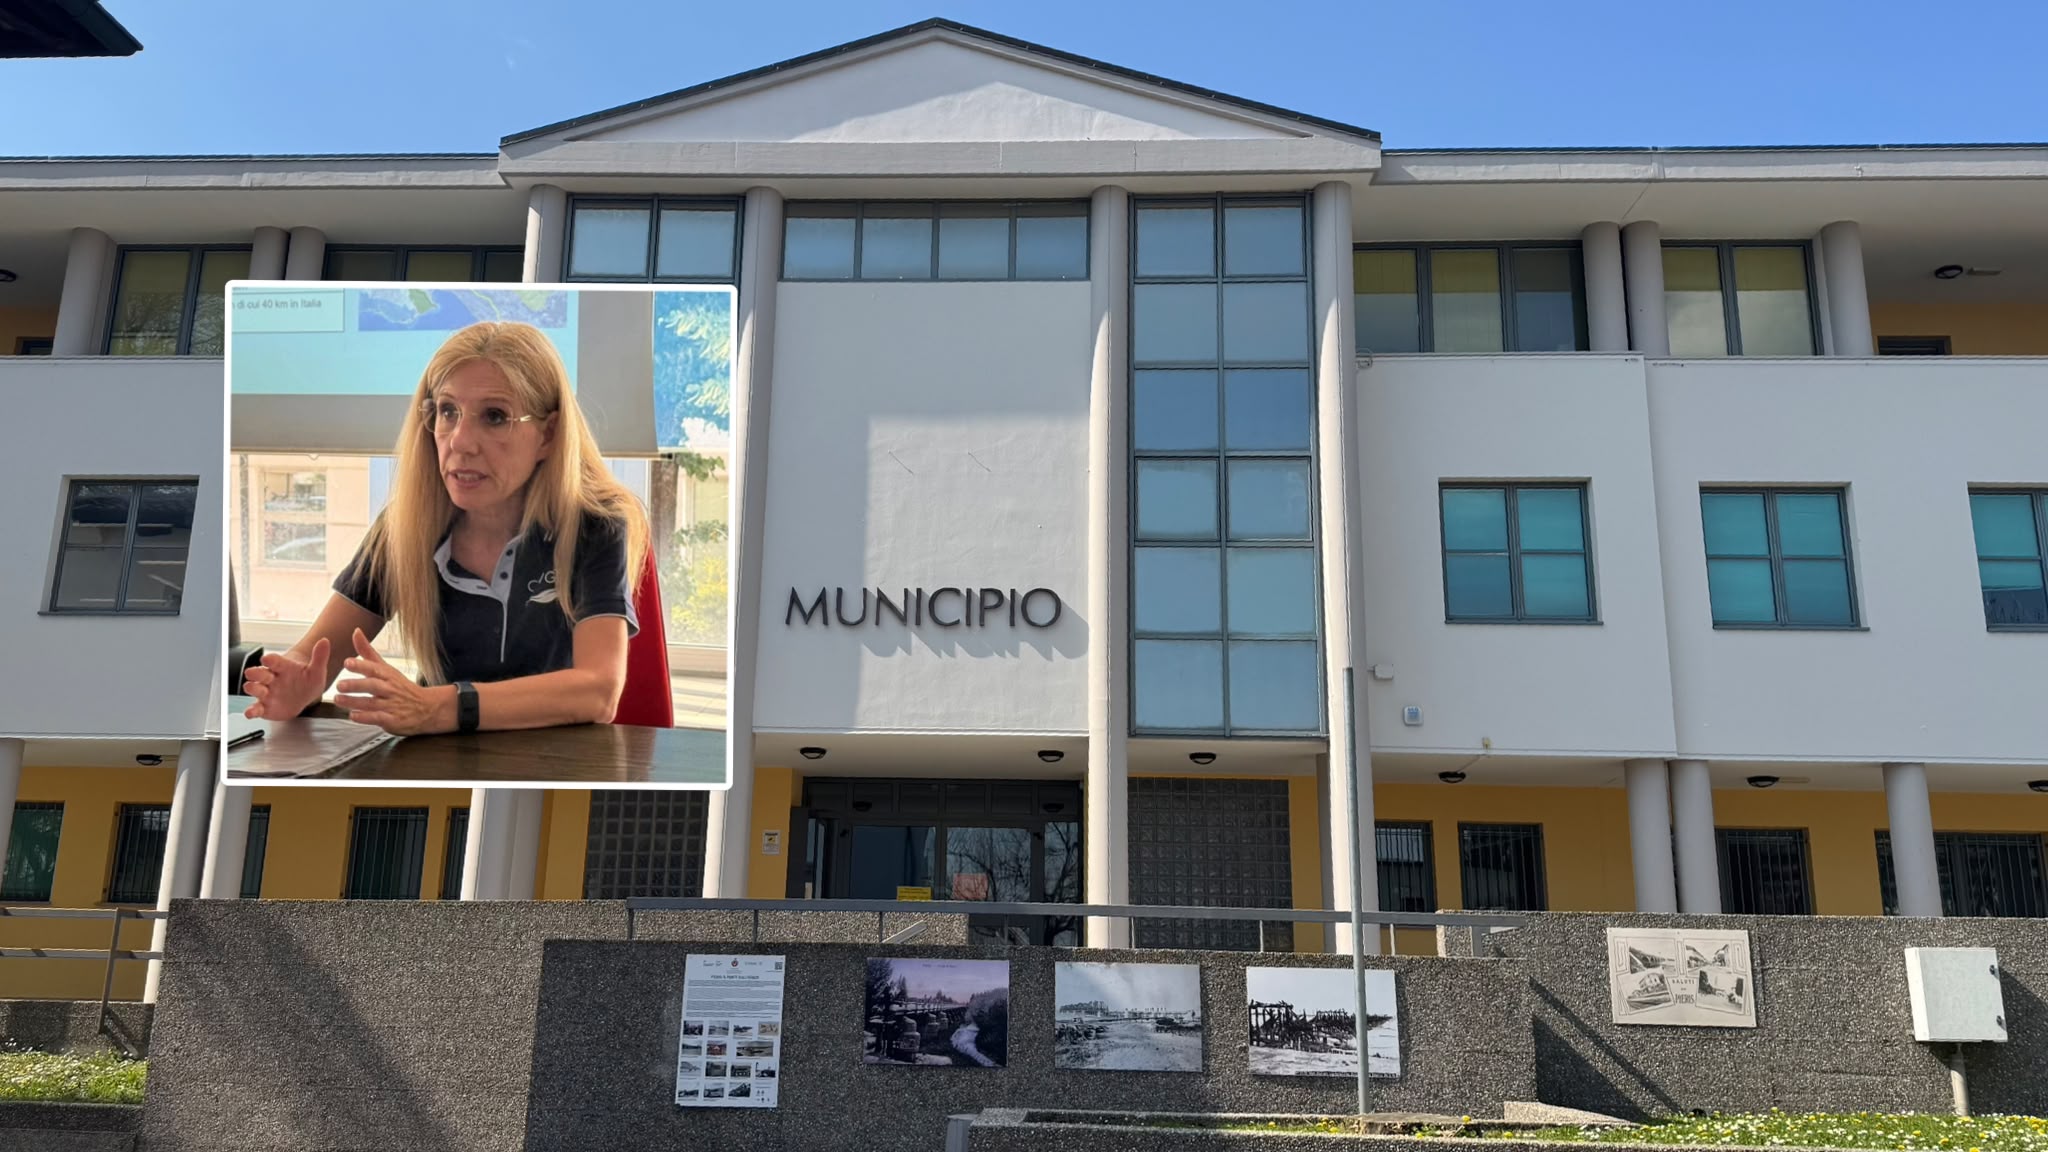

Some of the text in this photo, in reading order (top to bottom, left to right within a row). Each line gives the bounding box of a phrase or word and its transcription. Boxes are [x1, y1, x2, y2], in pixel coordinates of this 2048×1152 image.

[237, 299, 245, 309] di
[246, 299, 260, 309] cui
[262, 299, 273, 309] 40
[275, 298, 288, 308] km
[290, 298, 299, 308] in
[301, 298, 322, 308] Italia
[785, 586, 1062, 628] MUNICIPIO
